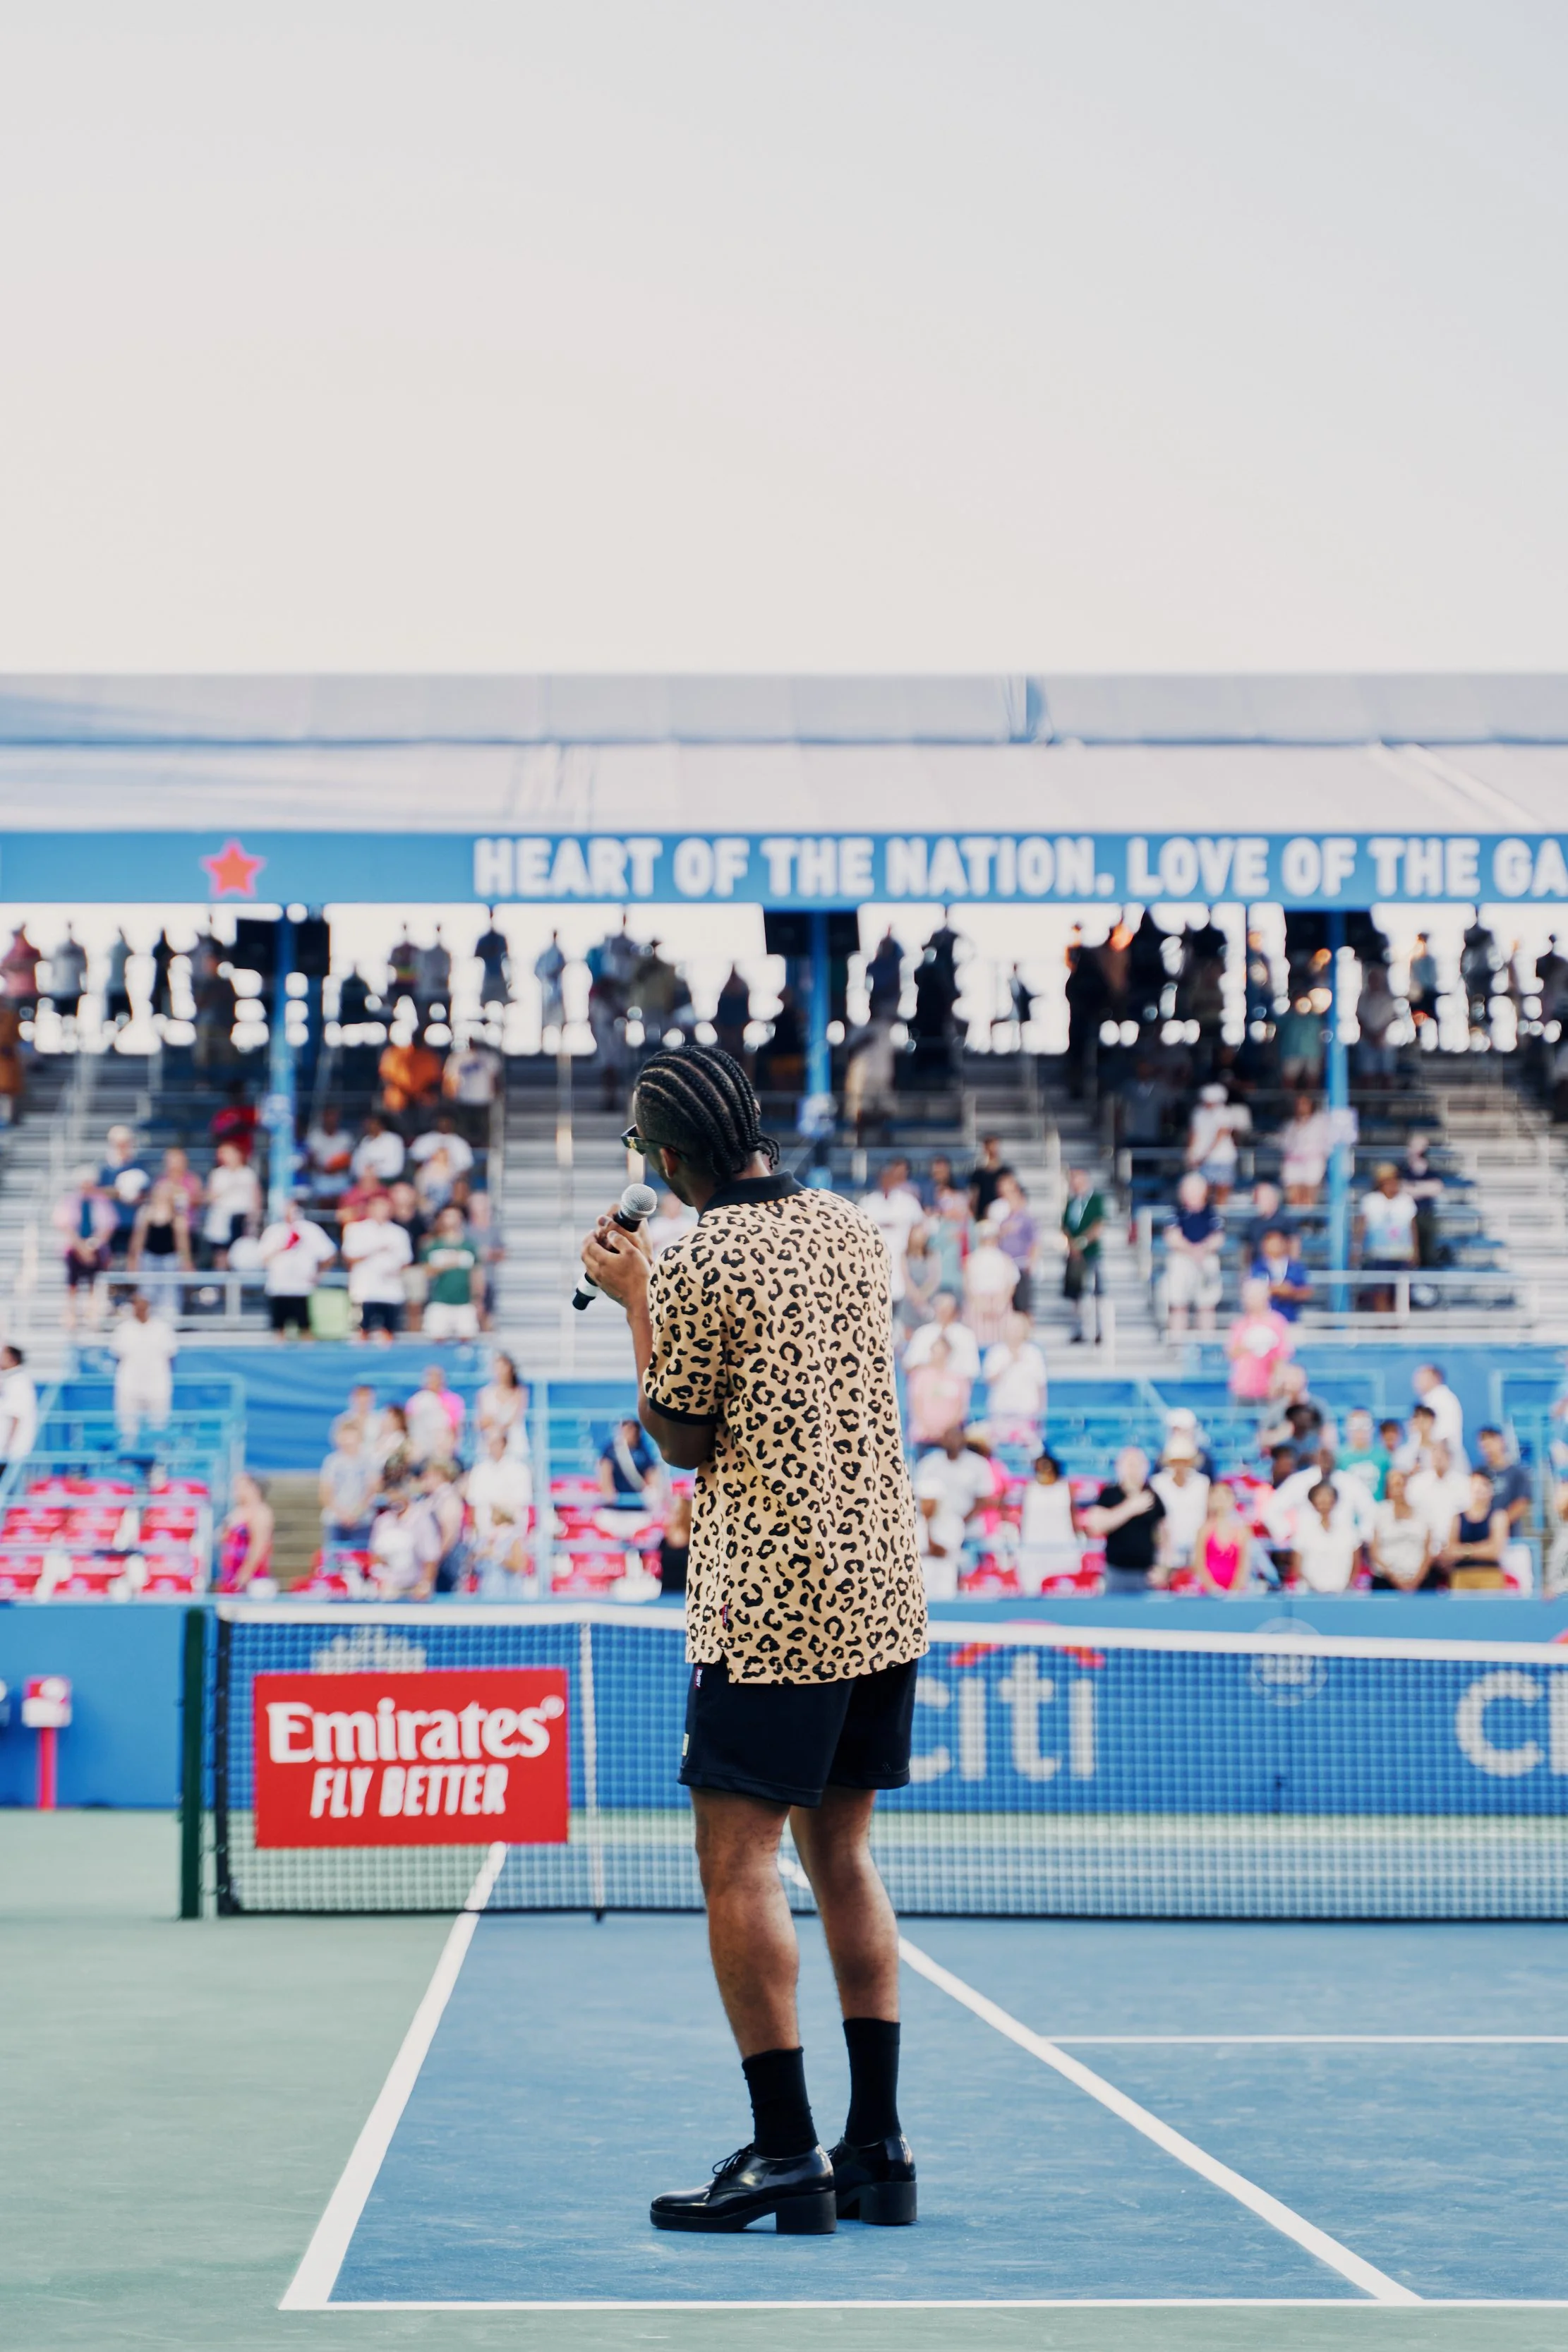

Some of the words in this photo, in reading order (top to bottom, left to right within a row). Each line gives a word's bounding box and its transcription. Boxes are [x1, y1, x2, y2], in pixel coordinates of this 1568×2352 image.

[474, 838, 662, 896] HEART
[673, 838, 749, 896] OF
[761, 838, 874, 896] THE
[886, 838, 1114, 896] NATION.
[1127, 838, 1270, 896] LOVE
[1282, 838, 1356, 896] OF
[1368, 838, 1480, 896] THE
[266, 1697, 550, 1763] Emirates
[310, 1766, 373, 1818] FLY
[378, 1764, 509, 1817] BETTER
